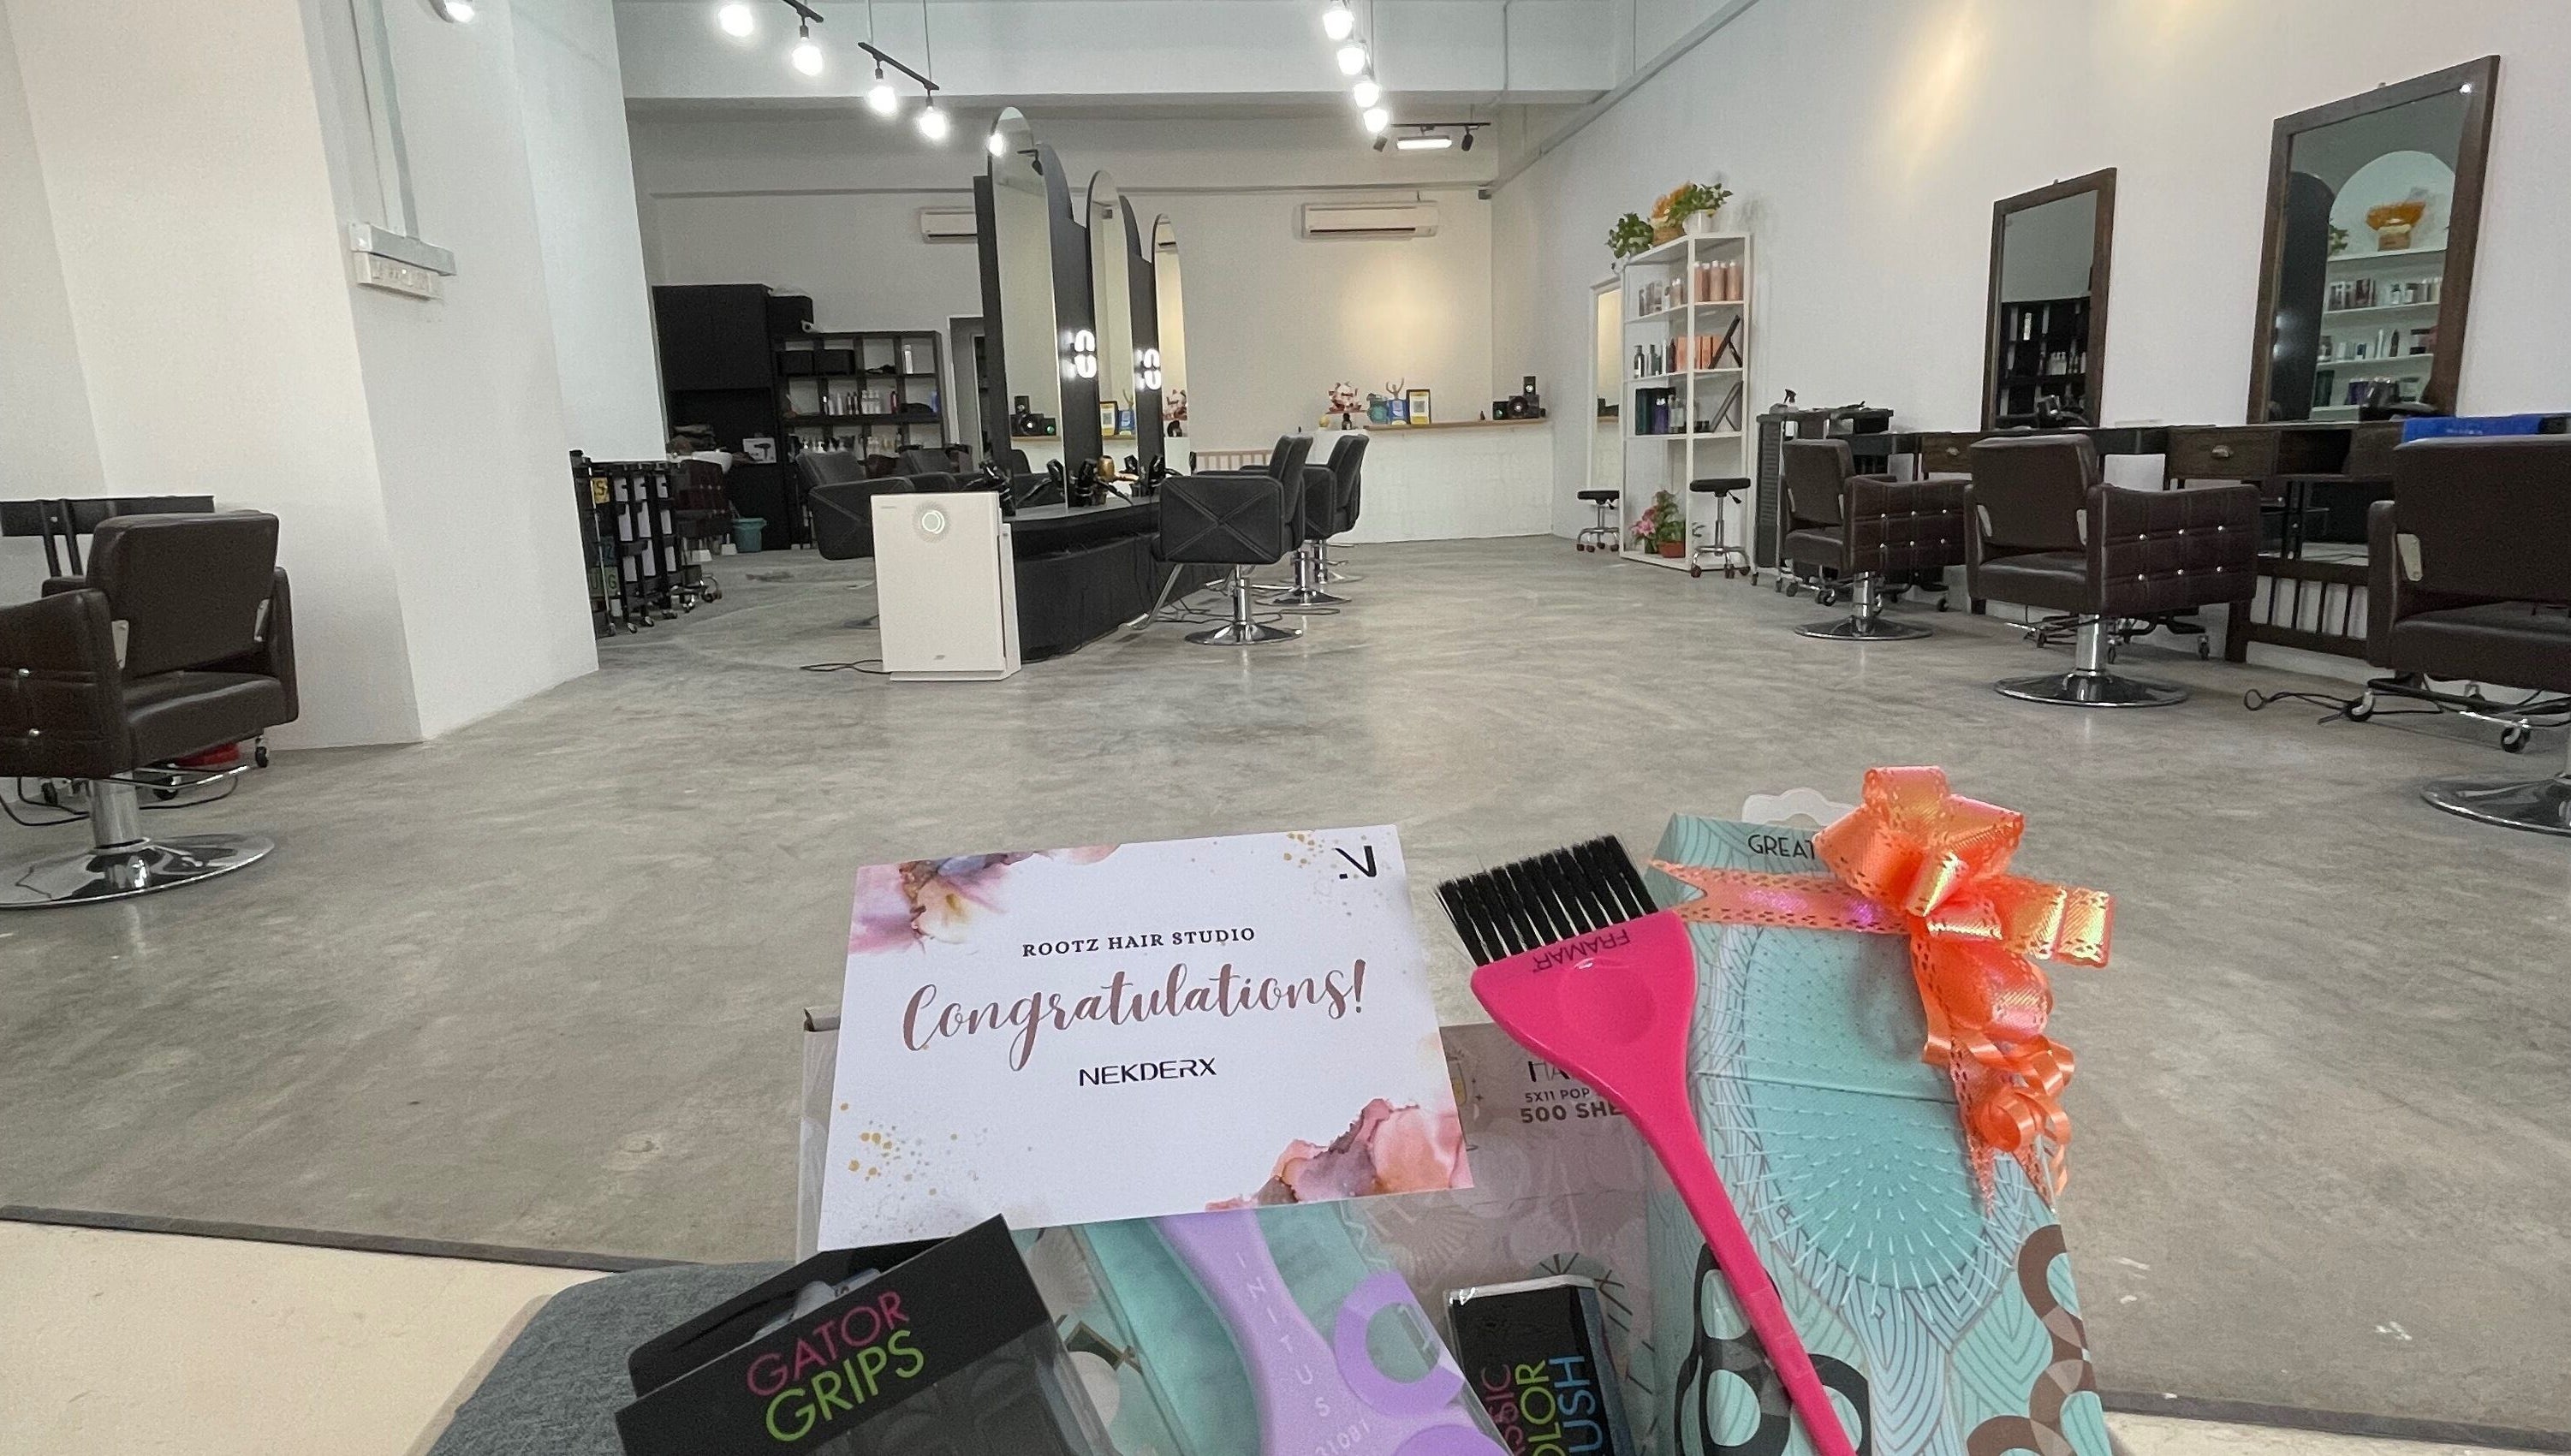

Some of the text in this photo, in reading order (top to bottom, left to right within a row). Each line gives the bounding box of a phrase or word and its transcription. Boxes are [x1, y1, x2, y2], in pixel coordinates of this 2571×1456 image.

[1747, 834, 1815, 860] GREAT
[1022, 927, 1255, 957] ROOTZ HAIR STUDIO
[1532, 928, 1631, 972] FRAMAR
[902, 959, 1367, 1073] Congratulations!
[1079, 1057, 1217, 1087] NEKDERX
[1560, 1087, 1591, 1101] POP
[1520, 1104, 1567, 1124] 500
[746, 1291, 910, 1397] GATOR
[765, 1329, 925, 1442] GRIPS
[1481, 1363, 1527, 1456] SSIC
